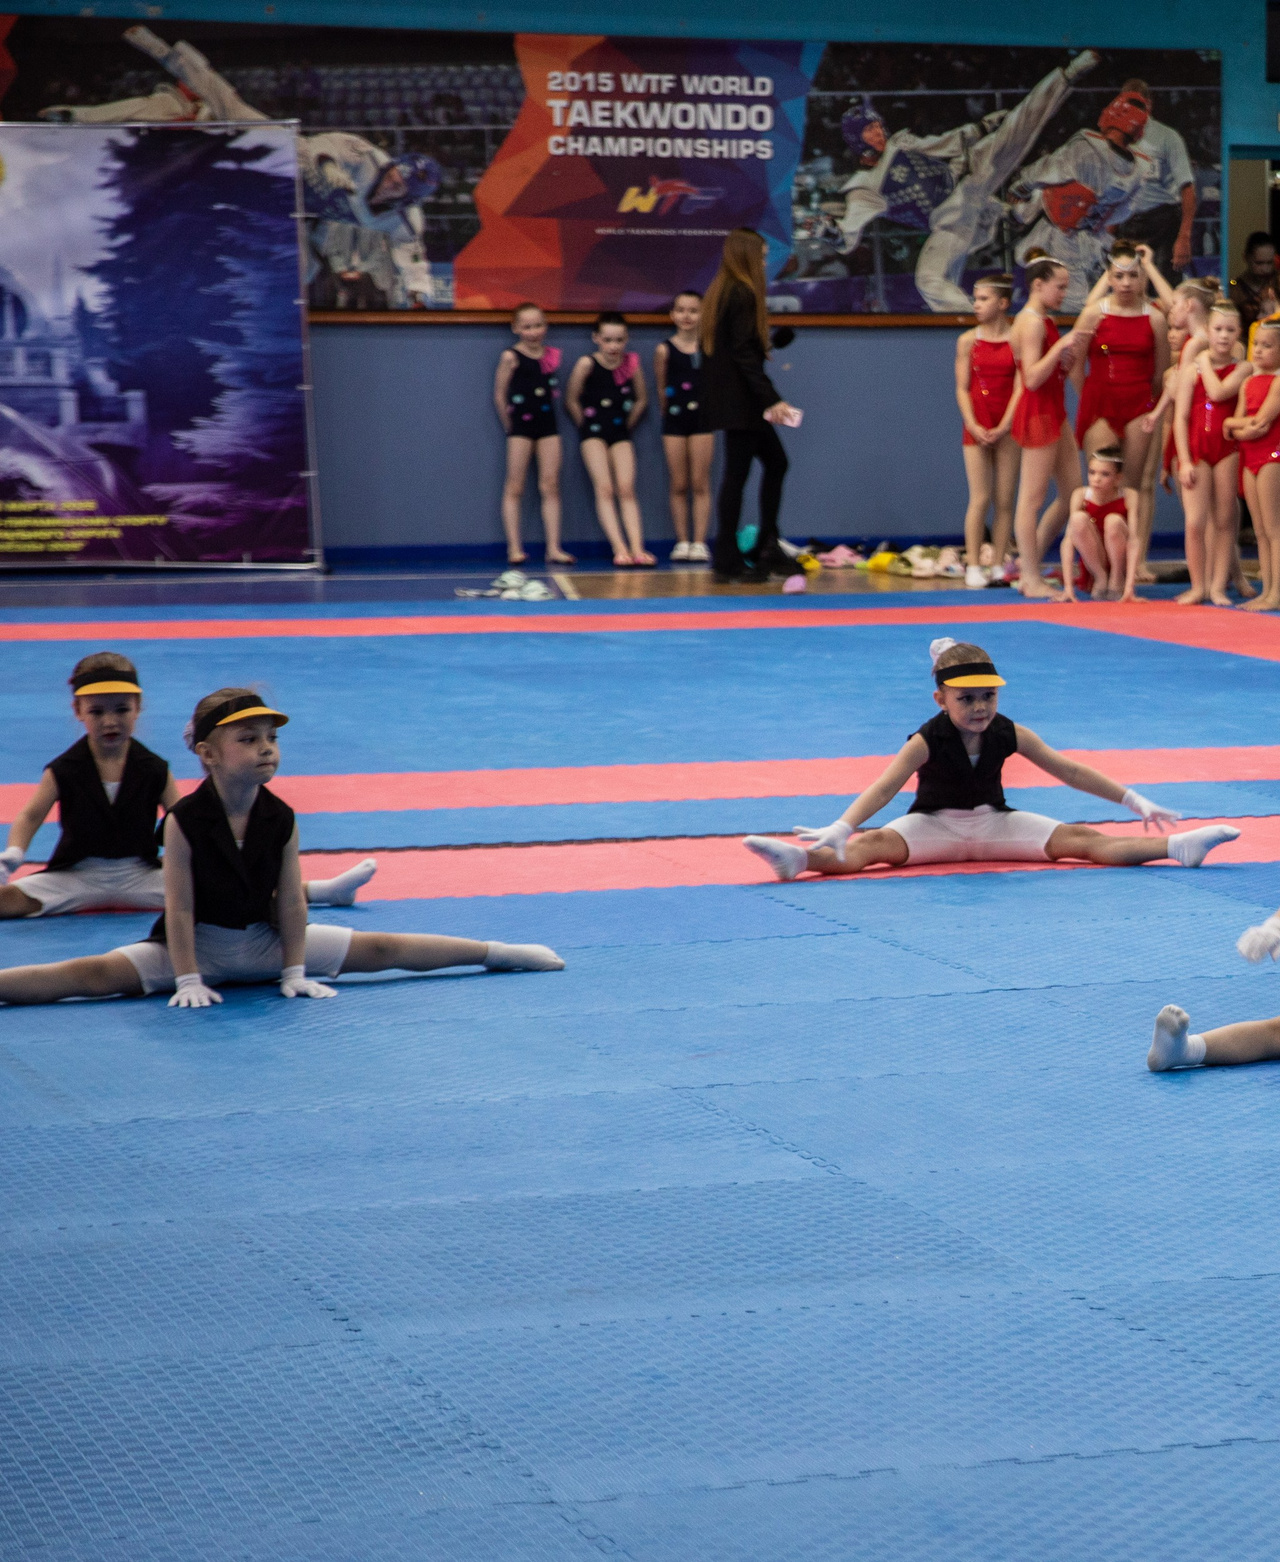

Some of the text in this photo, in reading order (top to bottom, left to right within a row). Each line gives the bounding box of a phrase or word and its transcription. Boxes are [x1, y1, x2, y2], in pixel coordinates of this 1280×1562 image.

[547, 71, 774, 96] 2015 WTF WORLD
[547, 99, 774, 131] TAEKWONDO
[548, 135, 774, 159] CHAMPIONSHIPS
